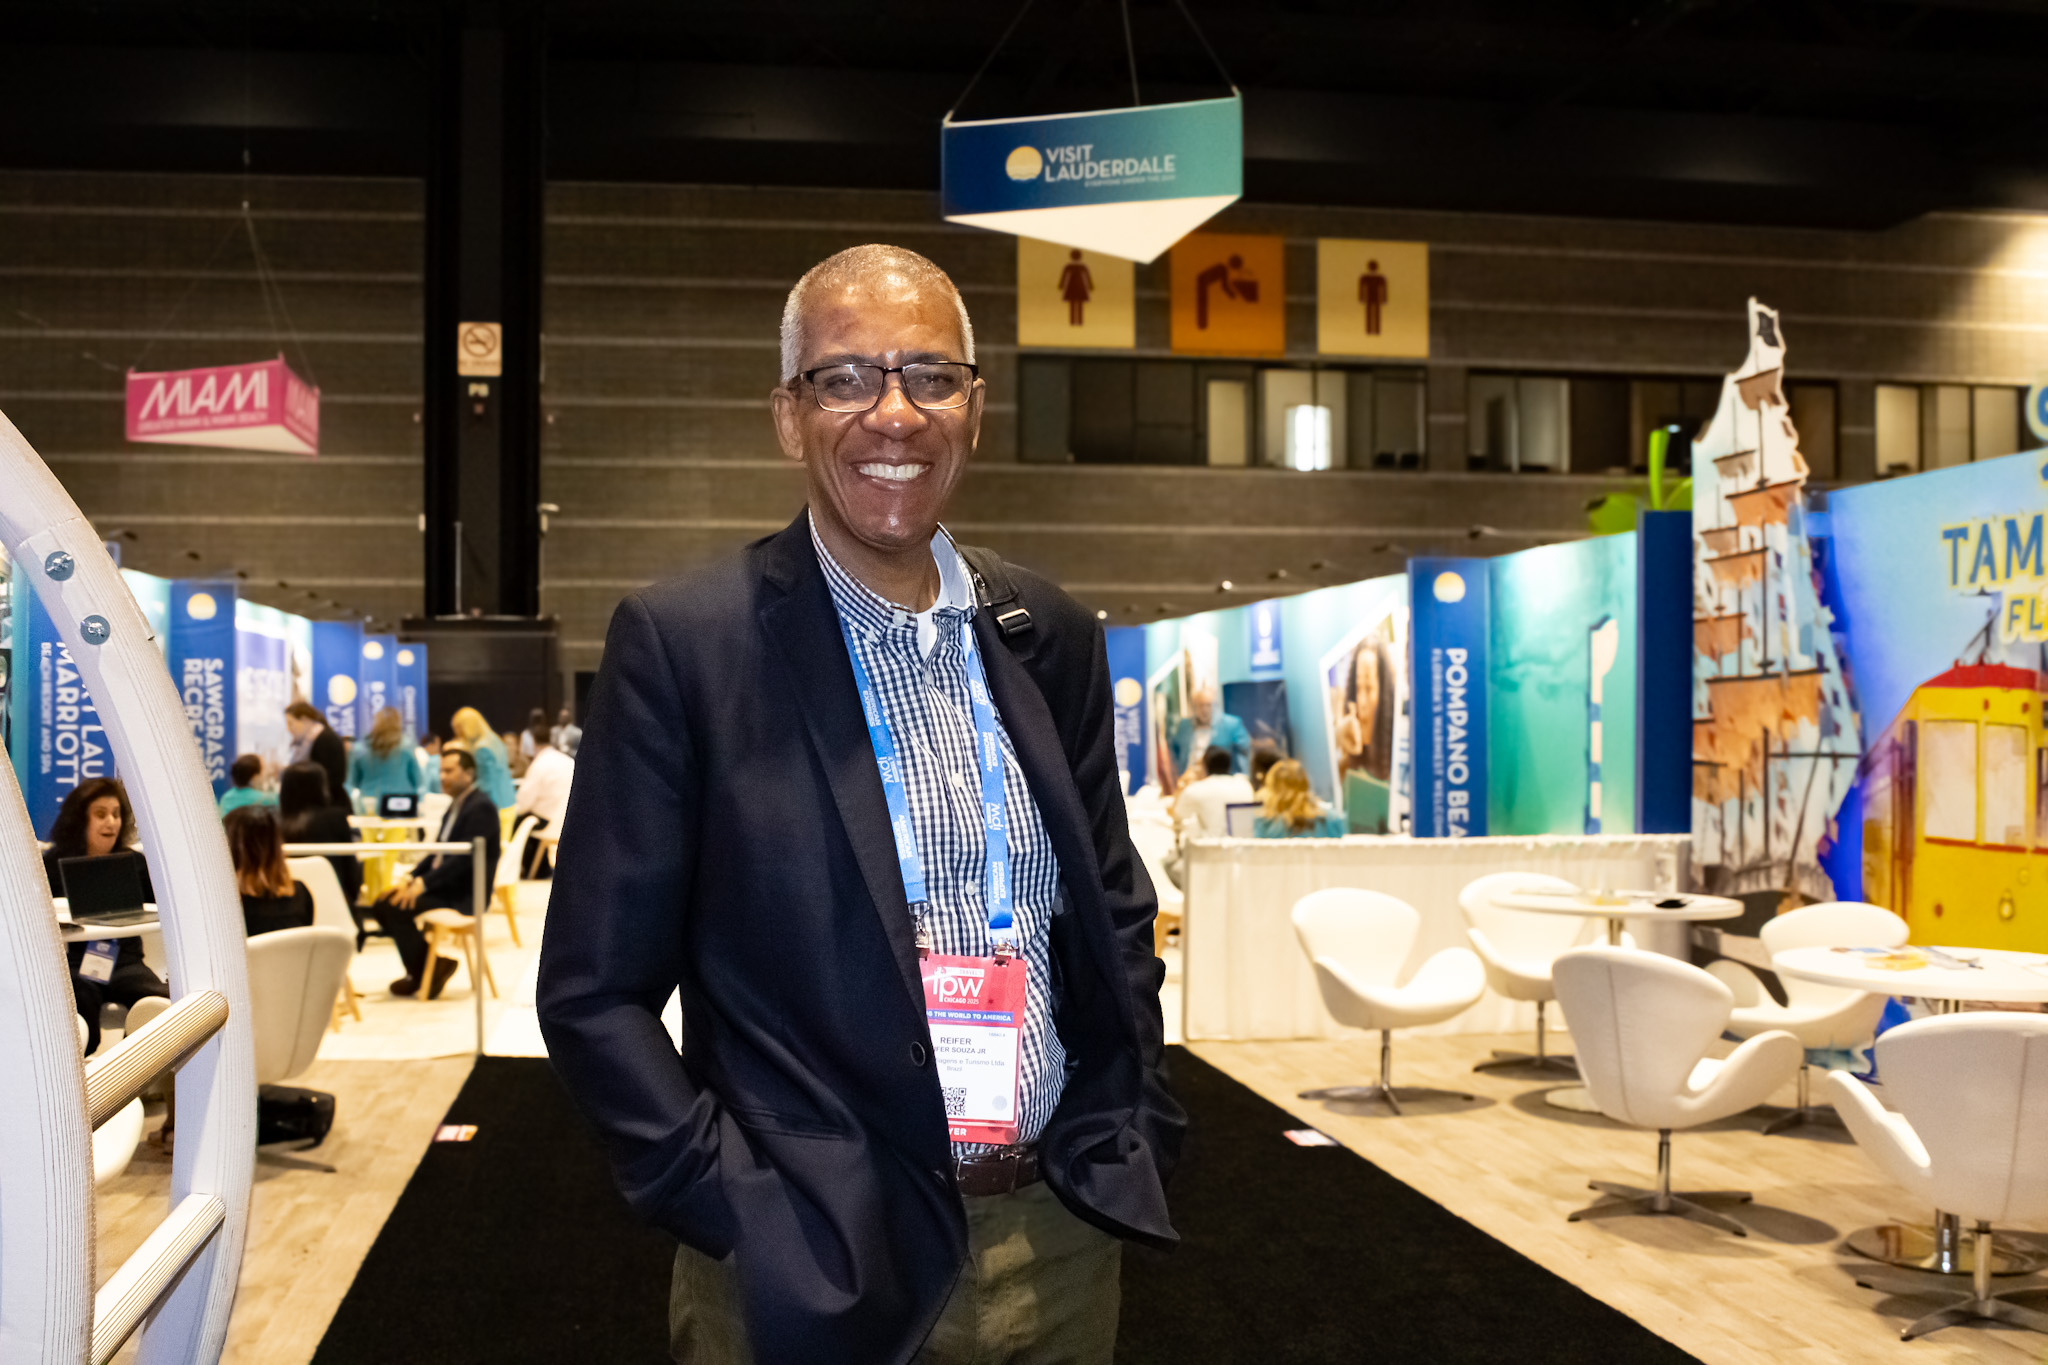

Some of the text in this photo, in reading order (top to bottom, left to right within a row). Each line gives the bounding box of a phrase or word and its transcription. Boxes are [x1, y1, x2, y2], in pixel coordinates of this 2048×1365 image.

[1045, 154, 1176, 182] LAUDERDALE
[1046, 144, 1093, 163] VISIT
[139, 369, 267, 420] MIAMI
[1942, 514, 2044, 586] TAM
[56, 642, 79, 787] MARRIOTT
[204, 658, 225, 781] SAWGRASS
[863, 690, 876, 728] EXPRESS
[867, 684, 881, 726] AMERICAN
[1446, 648, 1469, 785] POMPANO
[982, 732, 993, 773] AMERICAN
[987, 732, 999, 767] EXPRESS
[898, 814, 913, 858] AMERICAN
[992, 861, 1000, 905] AMERICAN
[998, 861, 1006, 899] EXPRESS
[944, 996, 966, 1004] CHICAGO
[940, 1037, 972, 1045] REIFER
